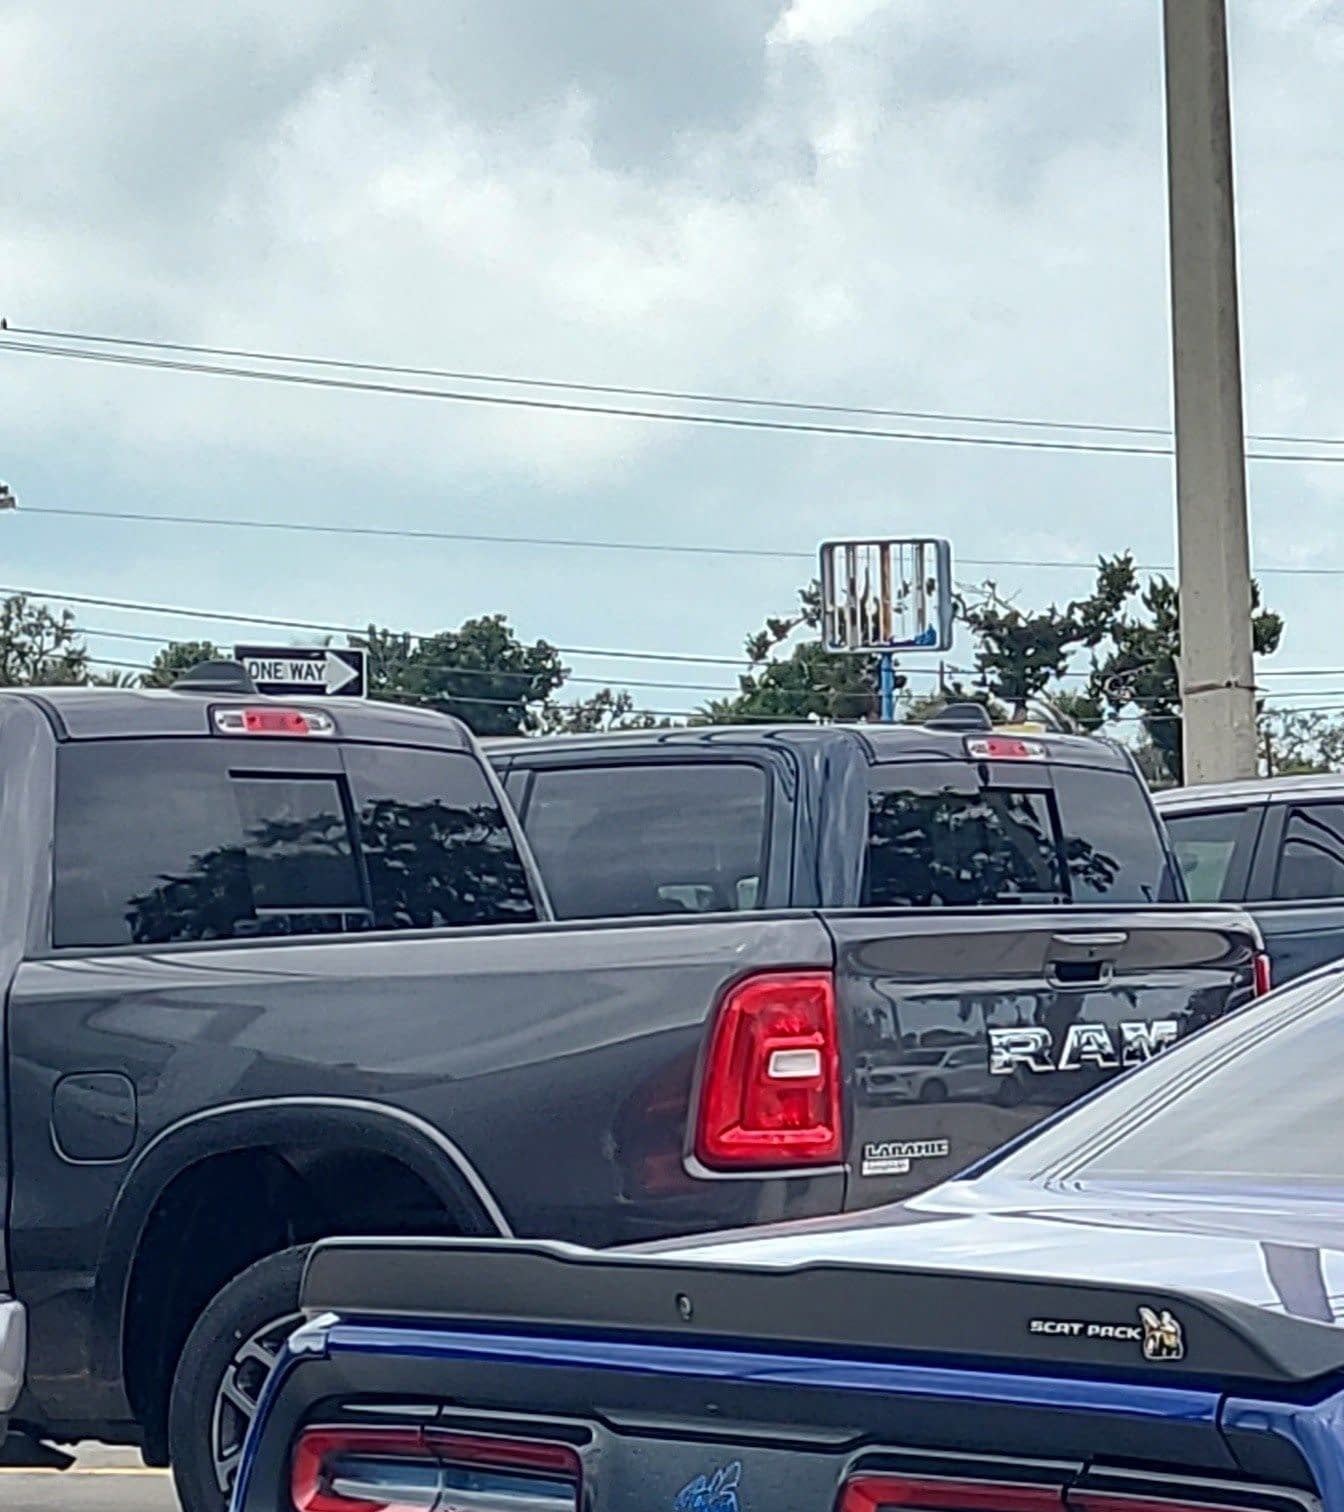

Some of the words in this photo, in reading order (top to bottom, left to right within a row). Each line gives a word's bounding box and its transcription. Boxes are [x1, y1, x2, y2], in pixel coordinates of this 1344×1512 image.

[248, 661, 284, 680] ONE
[290, 662, 326, 681] WAY
[989, 1020, 1178, 1074] RAM
[865, 1140, 949, 1159] LARAMIE
[1030, 1320, 1084, 1335] SCAT
[1087, 1324, 1142, 1340] PACK
